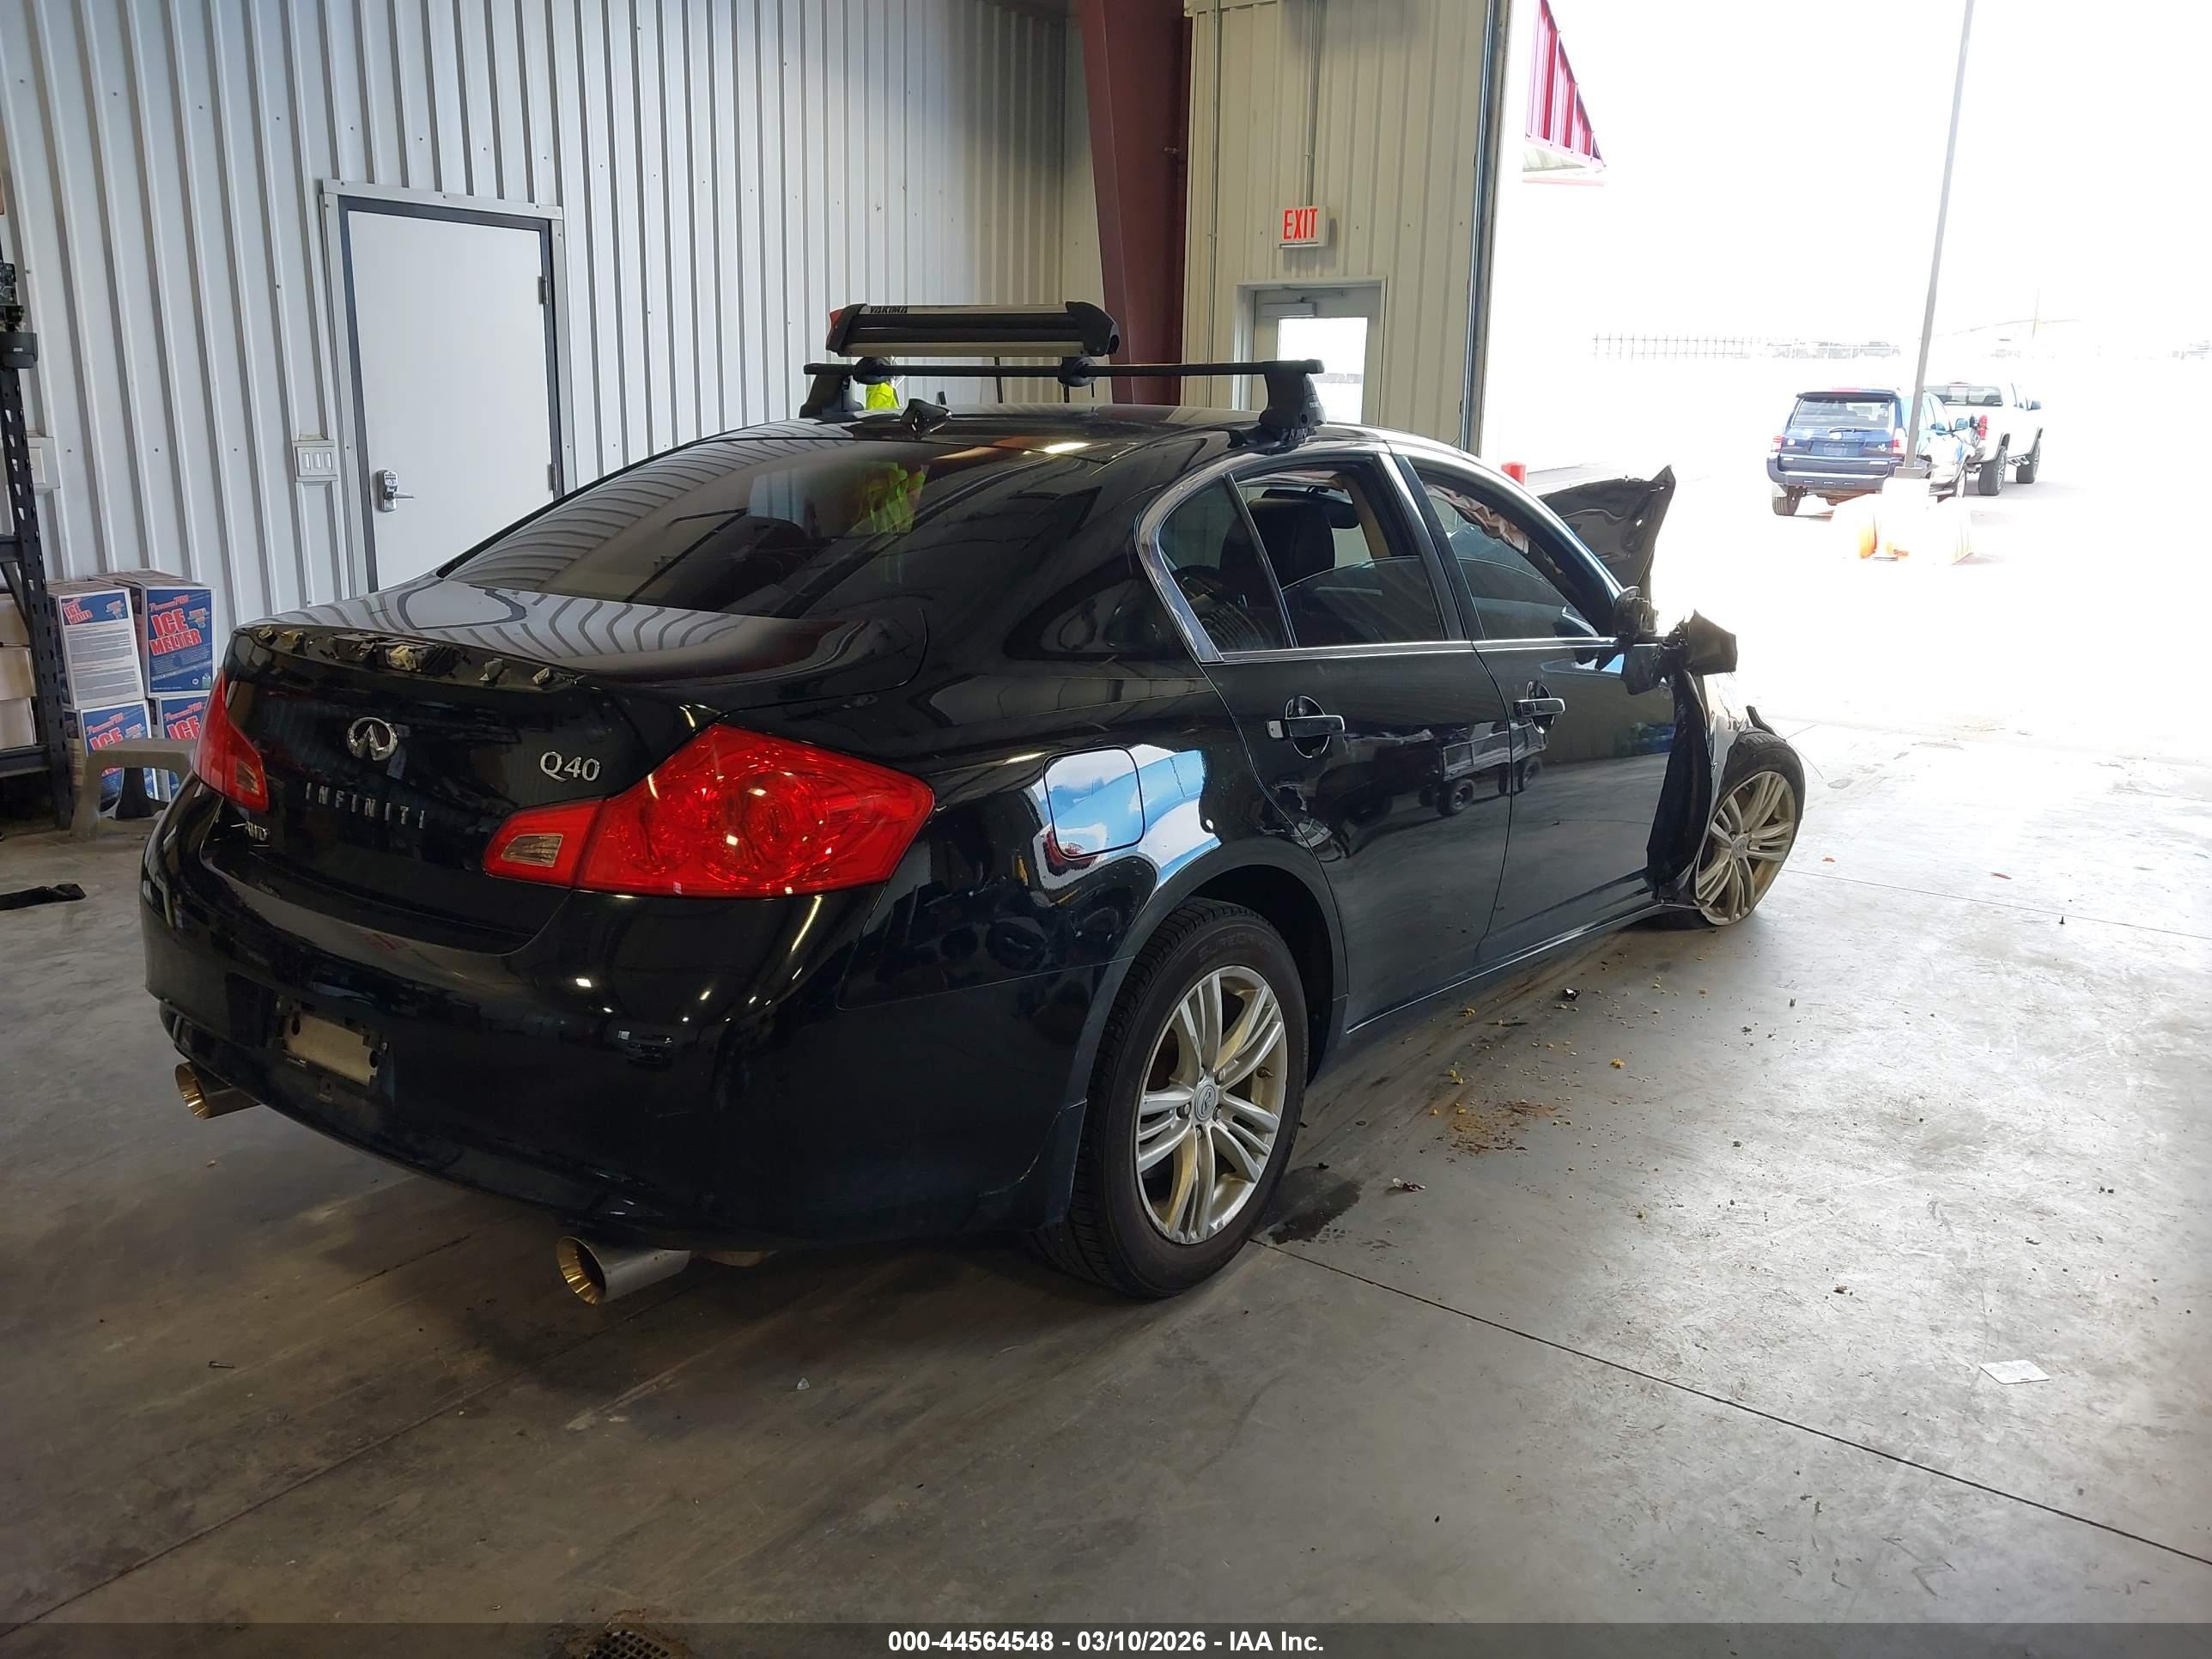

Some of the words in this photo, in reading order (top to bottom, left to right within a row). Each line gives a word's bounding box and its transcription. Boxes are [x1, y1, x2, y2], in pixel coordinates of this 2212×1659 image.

[1283, 207, 1318, 240] EXIT
[870, 306, 908, 314] YAKIMA
[150, 608, 189, 637] ICE
[149, 629, 203, 655] MELTER
[89, 727, 123, 750] ICE
[167, 715, 201, 739] ICE
[539, 750, 600, 782] Q40
[305, 782, 425, 830] INFINITI
